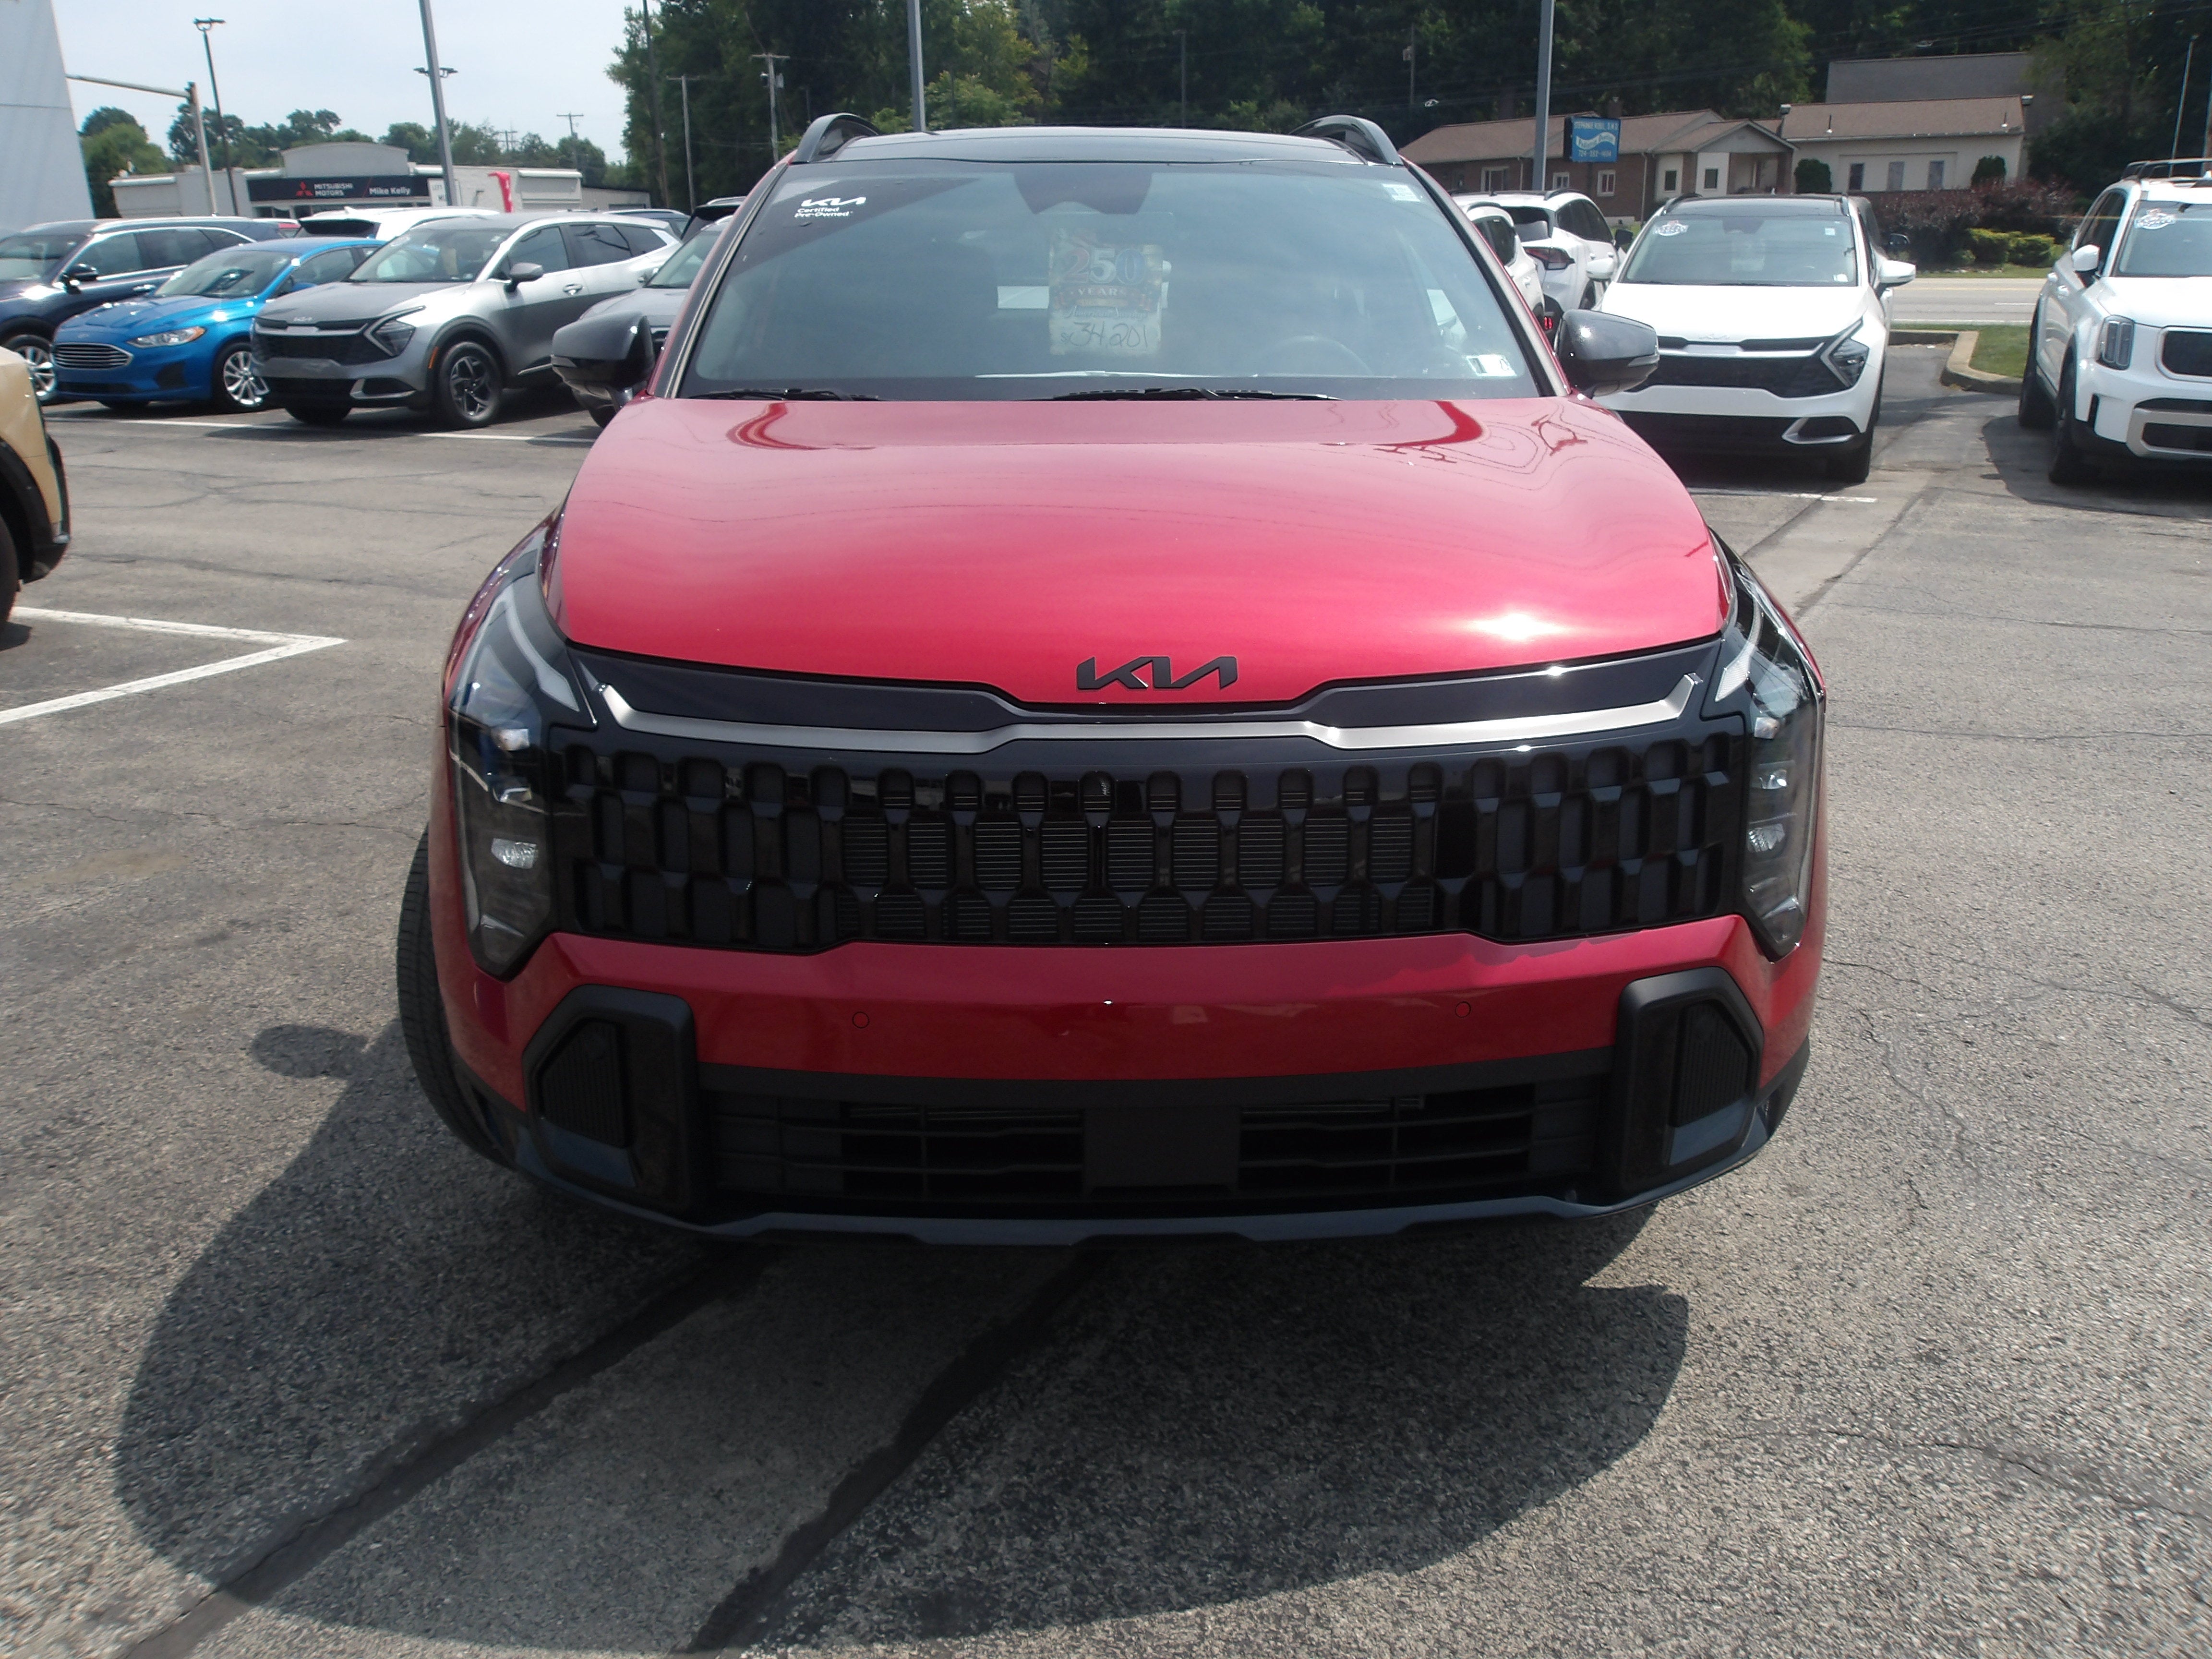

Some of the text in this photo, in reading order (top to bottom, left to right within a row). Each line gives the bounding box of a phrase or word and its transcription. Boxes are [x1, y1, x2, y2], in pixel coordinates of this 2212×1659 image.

[390, 187, 411, 195] Kelly
[1061, 247, 1146, 285] 250
[1077, 656, 1238, 690] KIA
